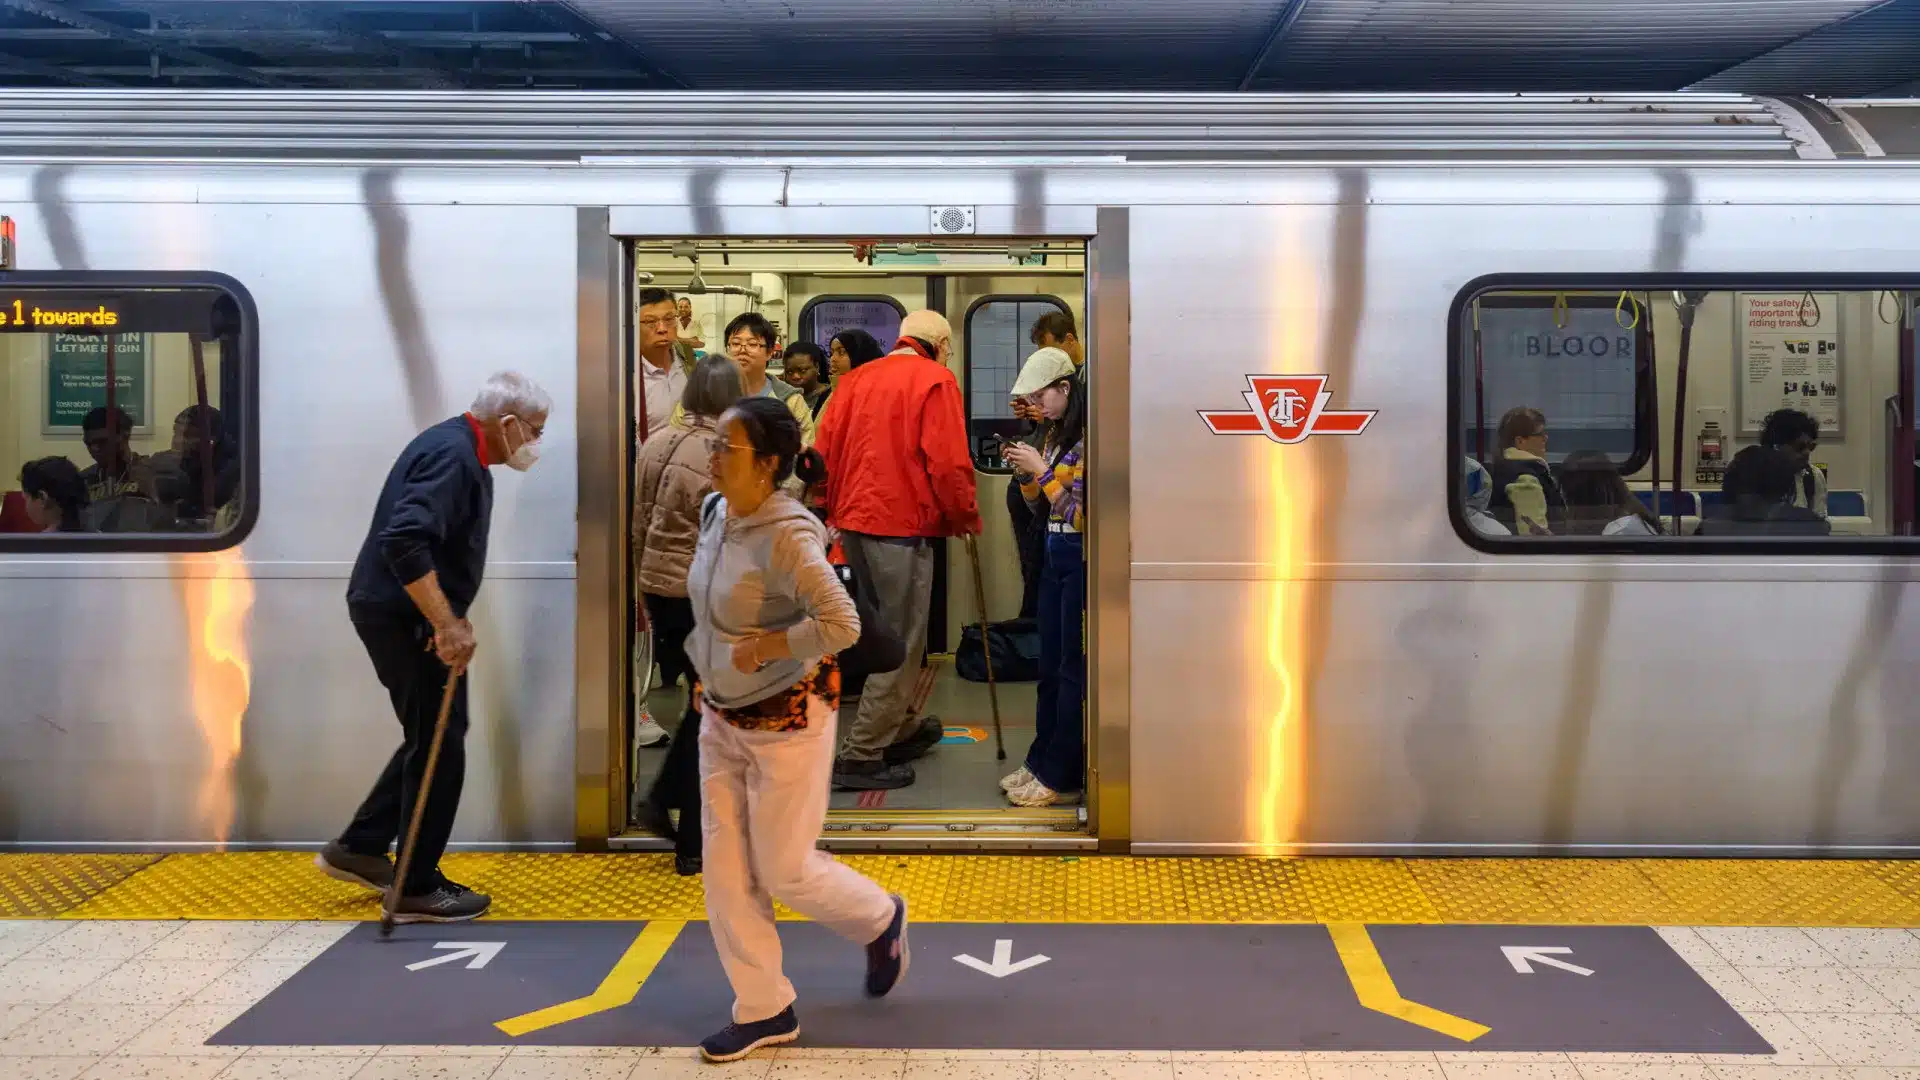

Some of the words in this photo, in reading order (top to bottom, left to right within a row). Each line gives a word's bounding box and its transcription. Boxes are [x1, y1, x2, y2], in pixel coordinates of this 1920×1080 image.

[1749, 299, 1770, 307] Your
[1773, 299, 1801, 309] safety
[13, 300, 25, 325] 1
[32, 305, 118, 326] towards
[1749, 309, 1794, 319] important
[1749, 319, 1776, 328] riding
[122, 332, 140, 342] IN
[55, 344, 77, 353] LET
[79, 344, 99, 353] ME
[1526, 335, 1632, 357] BLOOR
[56, 400, 92, 408] taskrabbit
